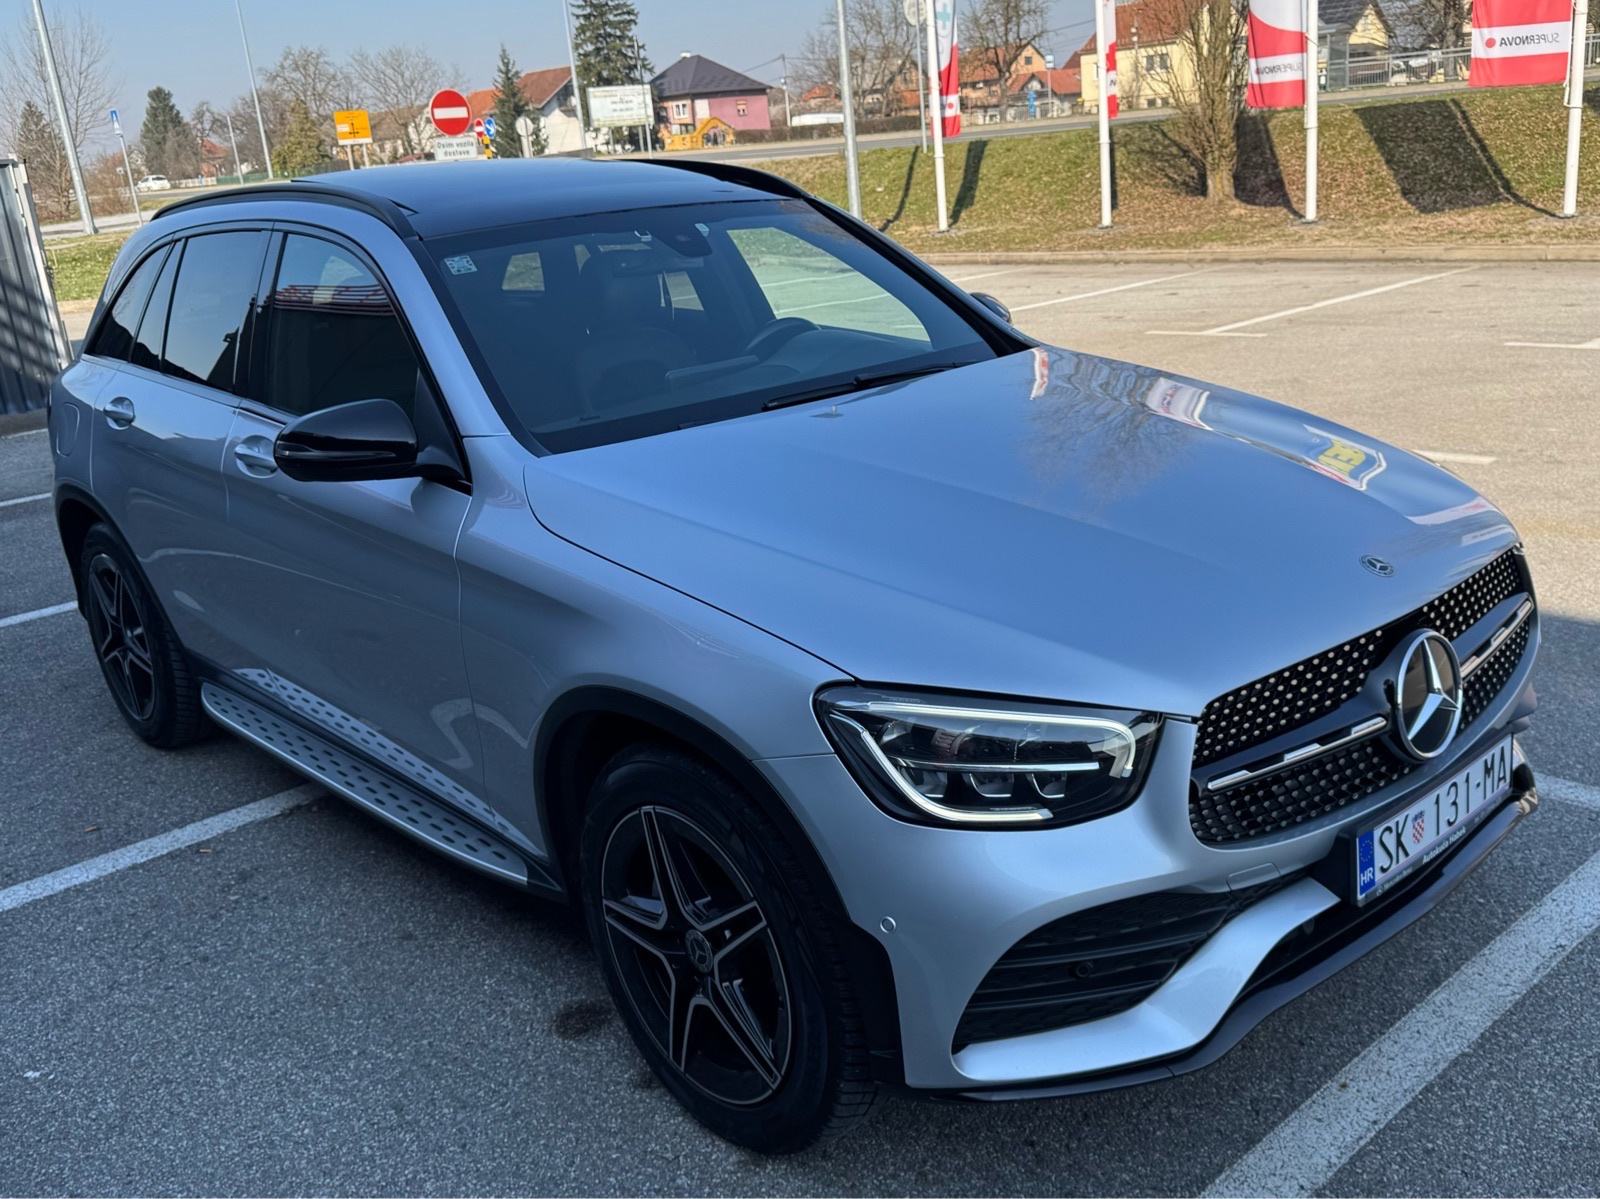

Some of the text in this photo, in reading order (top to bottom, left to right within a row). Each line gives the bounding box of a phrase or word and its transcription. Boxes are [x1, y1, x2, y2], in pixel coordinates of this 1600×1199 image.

[1379, 746, 1507, 873] SK 131-MA
[1360, 867, 1374, 886] HR
